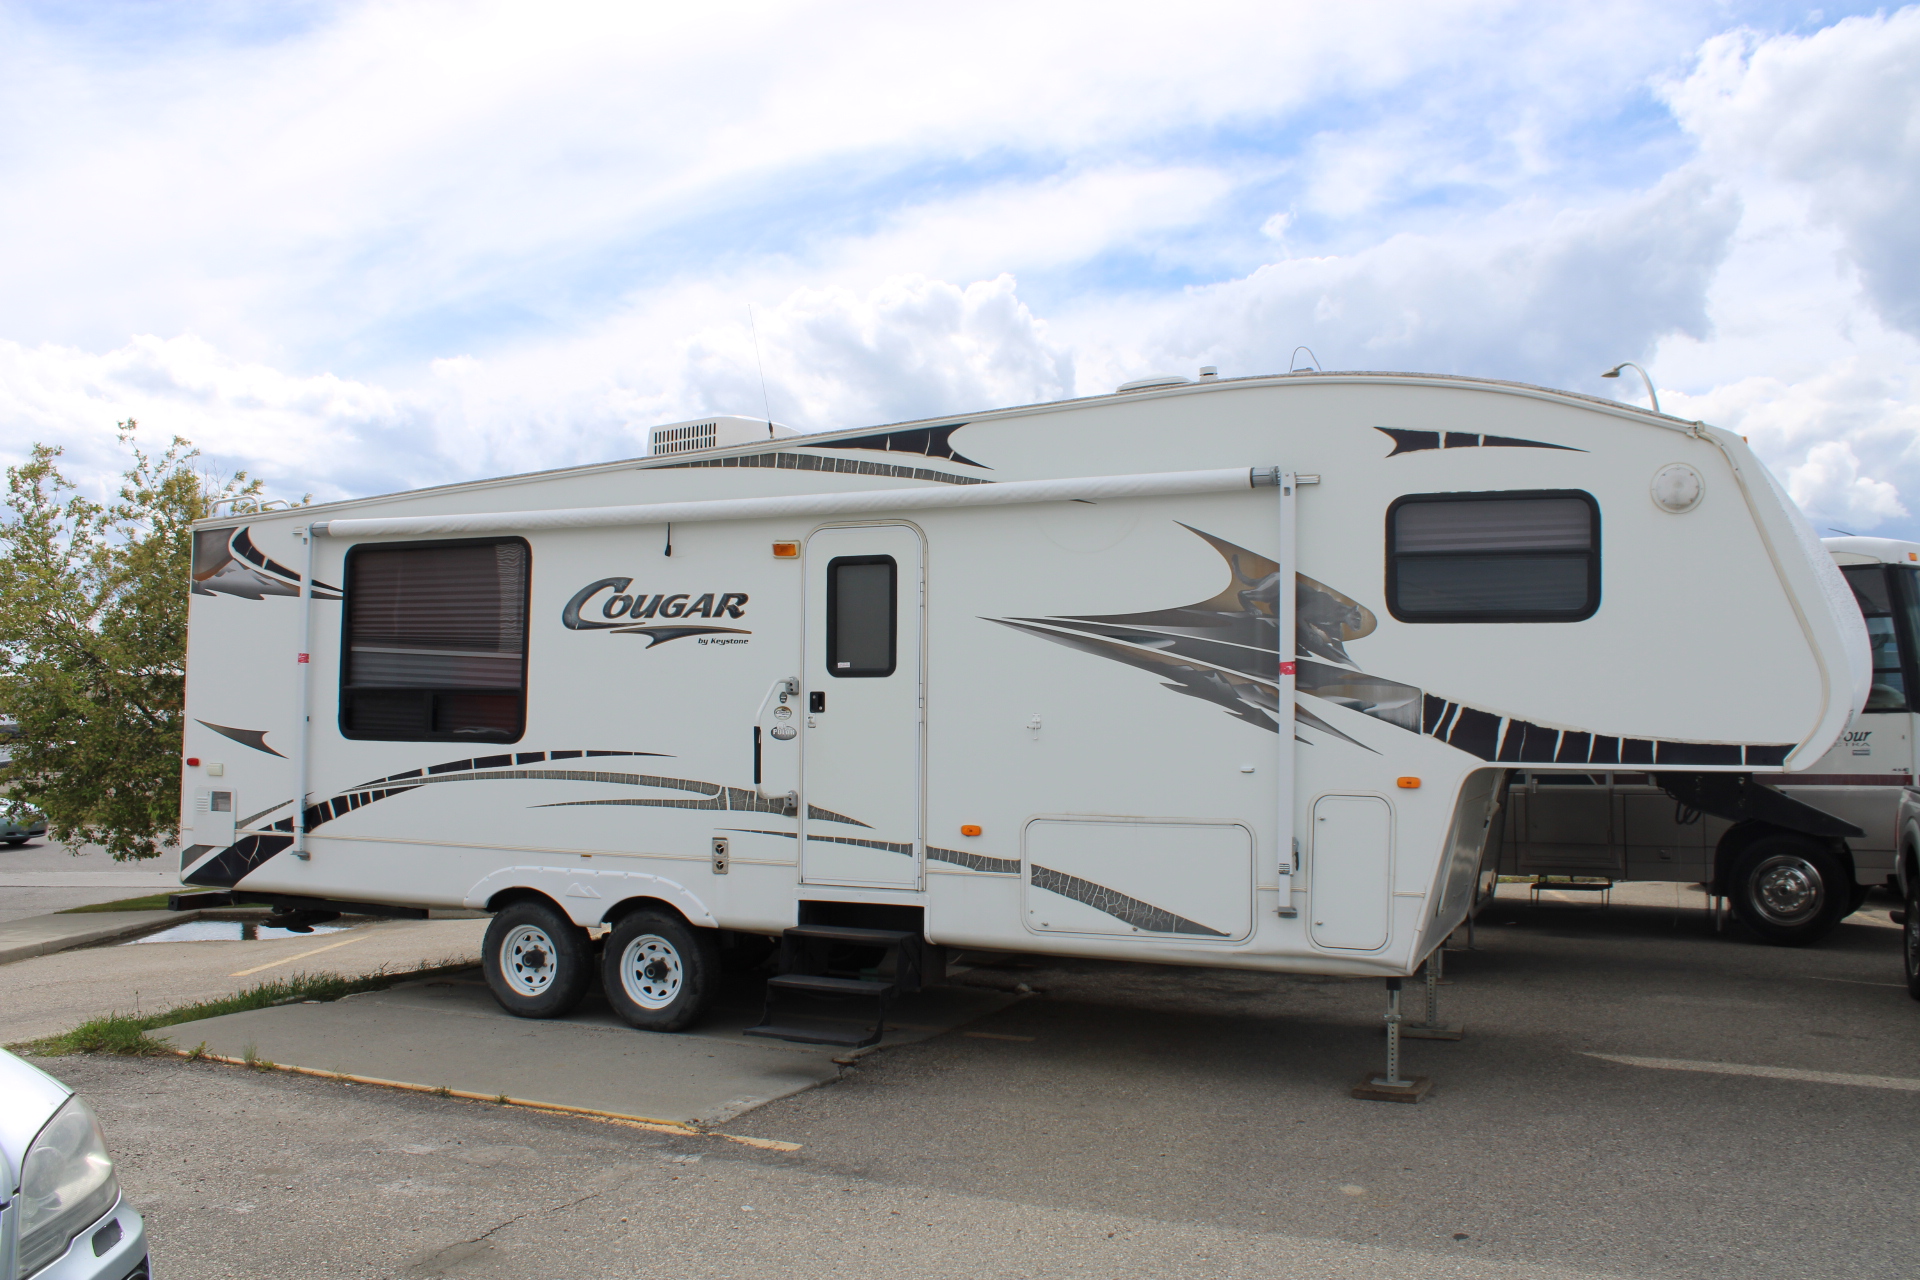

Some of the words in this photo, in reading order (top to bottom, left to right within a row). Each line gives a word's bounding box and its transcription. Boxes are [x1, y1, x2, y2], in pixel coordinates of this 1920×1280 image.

[562, 576, 749, 631] COUGAR
[698, 637, 709, 646] by
[710, 637, 749, 646] Keystone
